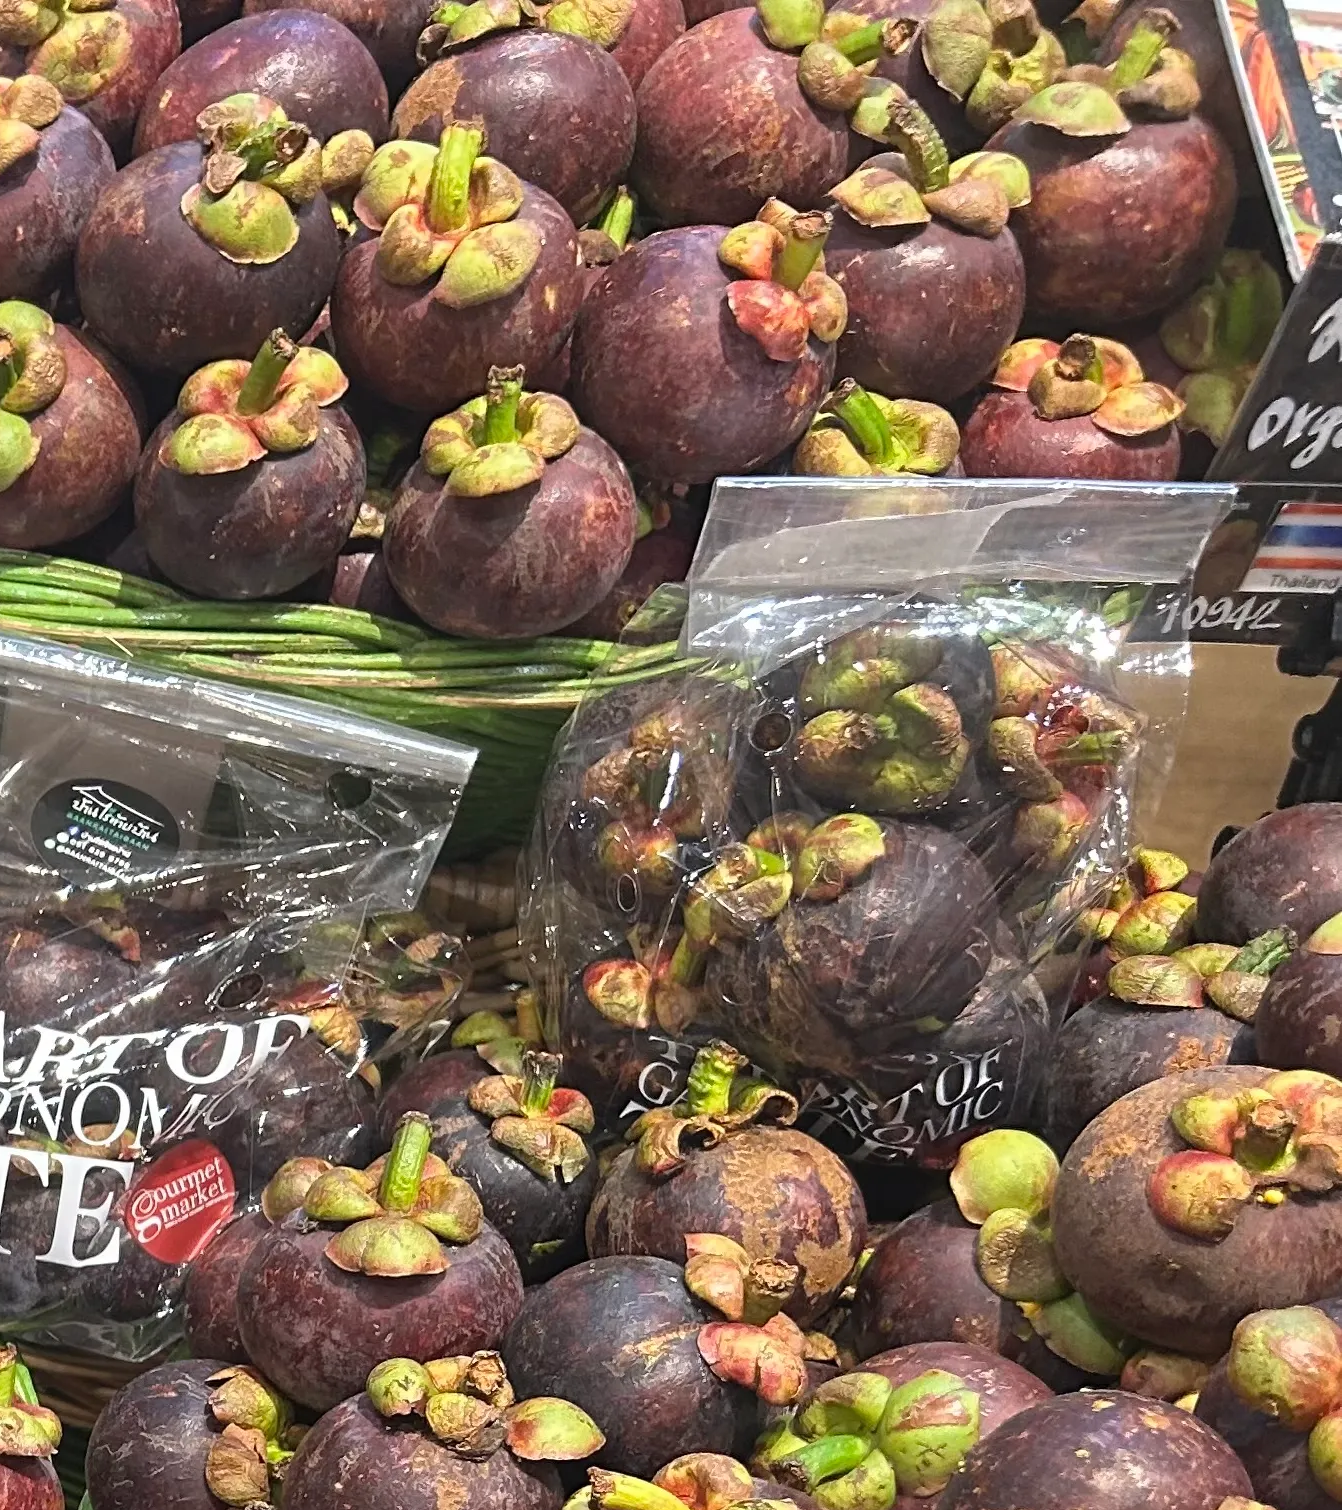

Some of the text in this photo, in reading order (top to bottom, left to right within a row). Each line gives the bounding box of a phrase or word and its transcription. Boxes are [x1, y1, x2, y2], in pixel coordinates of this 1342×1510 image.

[1270, 574, 1341, 589] Thailand
[166, 1013, 311, 1087] OF
[934, 1039, 1013, 1108] OF
[159, 1176, 228, 1222] market
